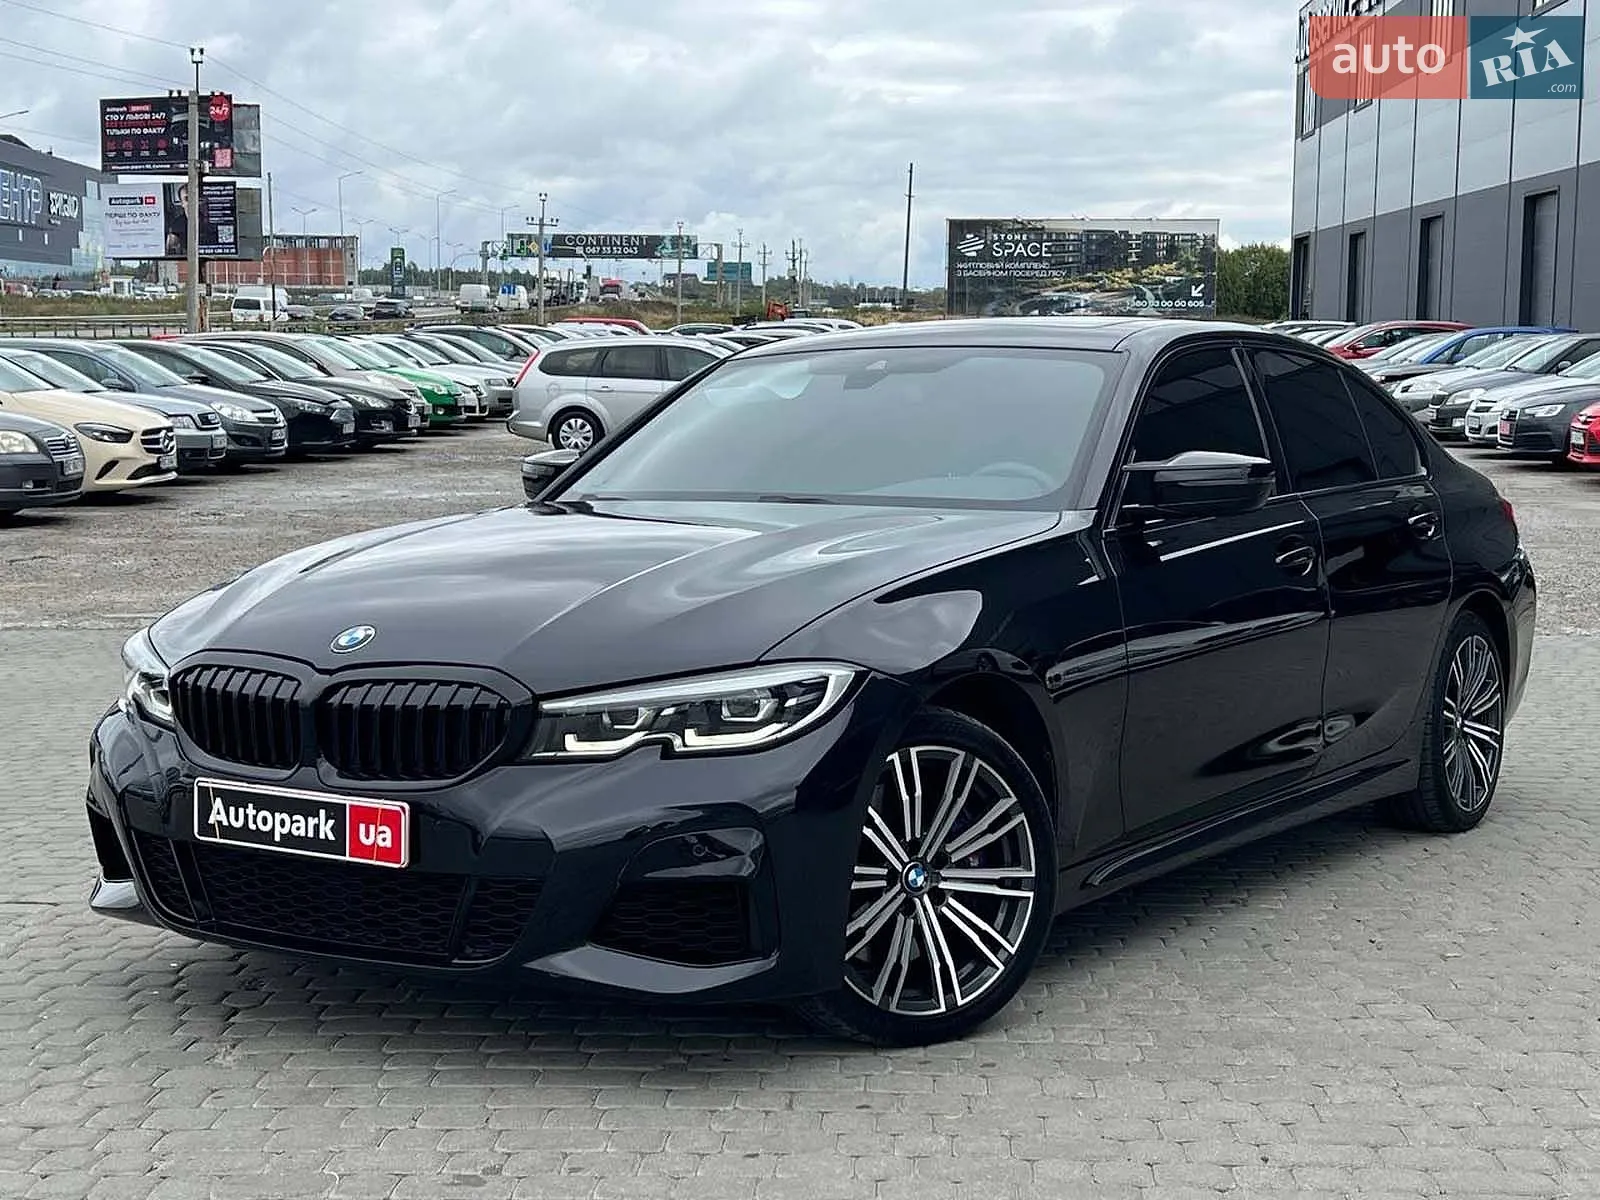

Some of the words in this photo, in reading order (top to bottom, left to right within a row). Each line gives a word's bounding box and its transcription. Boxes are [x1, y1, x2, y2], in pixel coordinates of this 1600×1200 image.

[210, 103, 229, 115] 24/7
[151, 112, 166, 120] 24/7
[565, 235, 648, 246] CONTINENT
[992, 242, 1052, 257] SPACE
[208, 797, 335, 841] Autopark
[359, 823, 392, 848] ua
